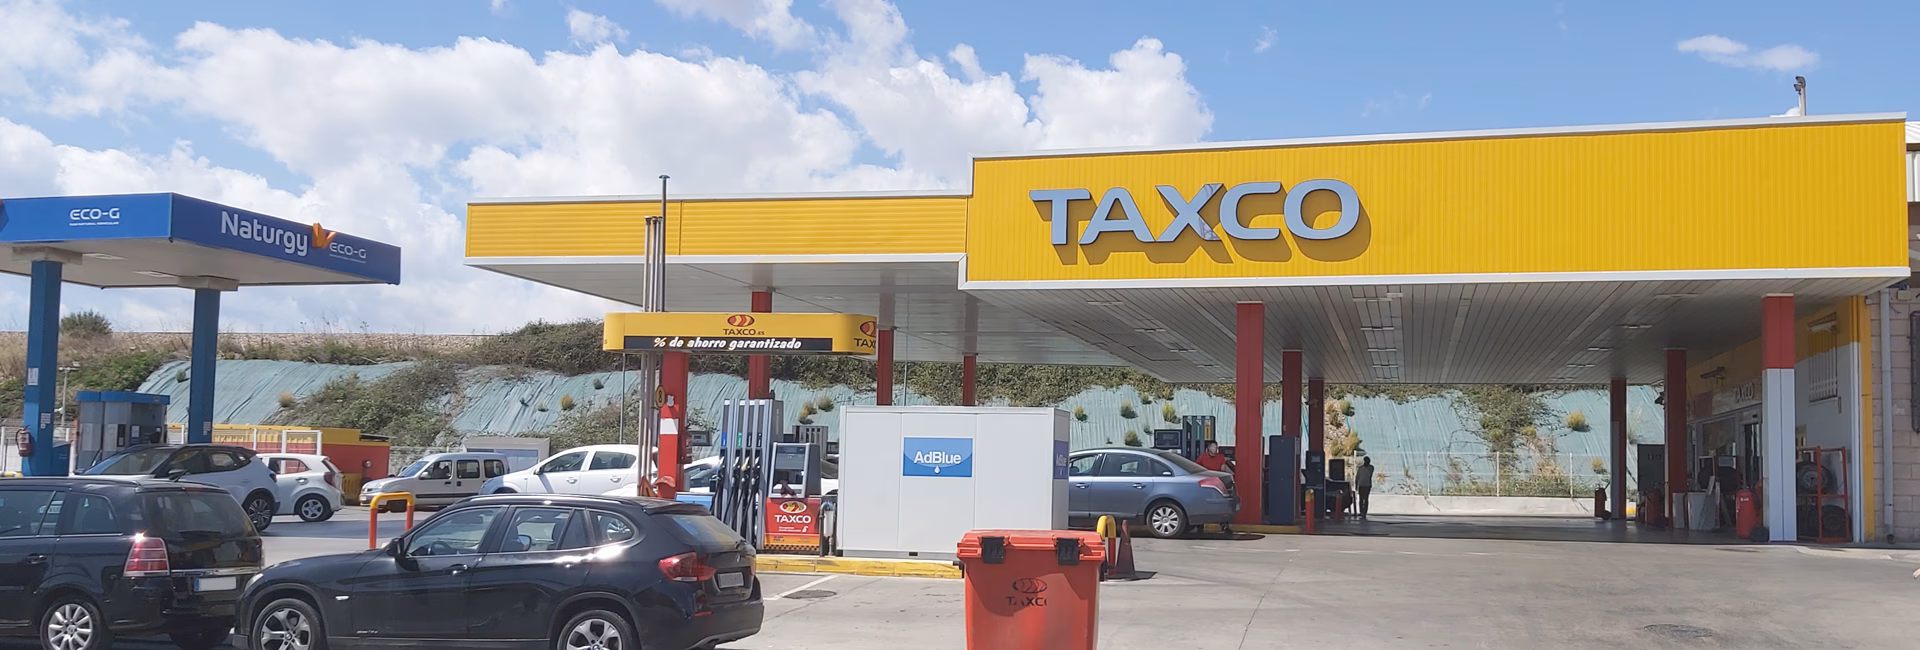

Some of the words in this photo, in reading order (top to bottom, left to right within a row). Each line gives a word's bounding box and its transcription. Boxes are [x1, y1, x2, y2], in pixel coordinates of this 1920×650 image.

[70, 207, 120, 220] ECO-G
[1029, 178, 1361, 246] TAXCO
[221, 211, 308, 257] Naturgy
[329, 242, 367, 259] ECO-G
[653, 337, 667, 348] %
[669, 336, 684, 348] de
[687, 337, 726, 349] ahorro
[728, 338, 802, 350] garantizado
[913, 451, 962, 464] AdBlue
[774, 514, 812, 524] TAXCO
